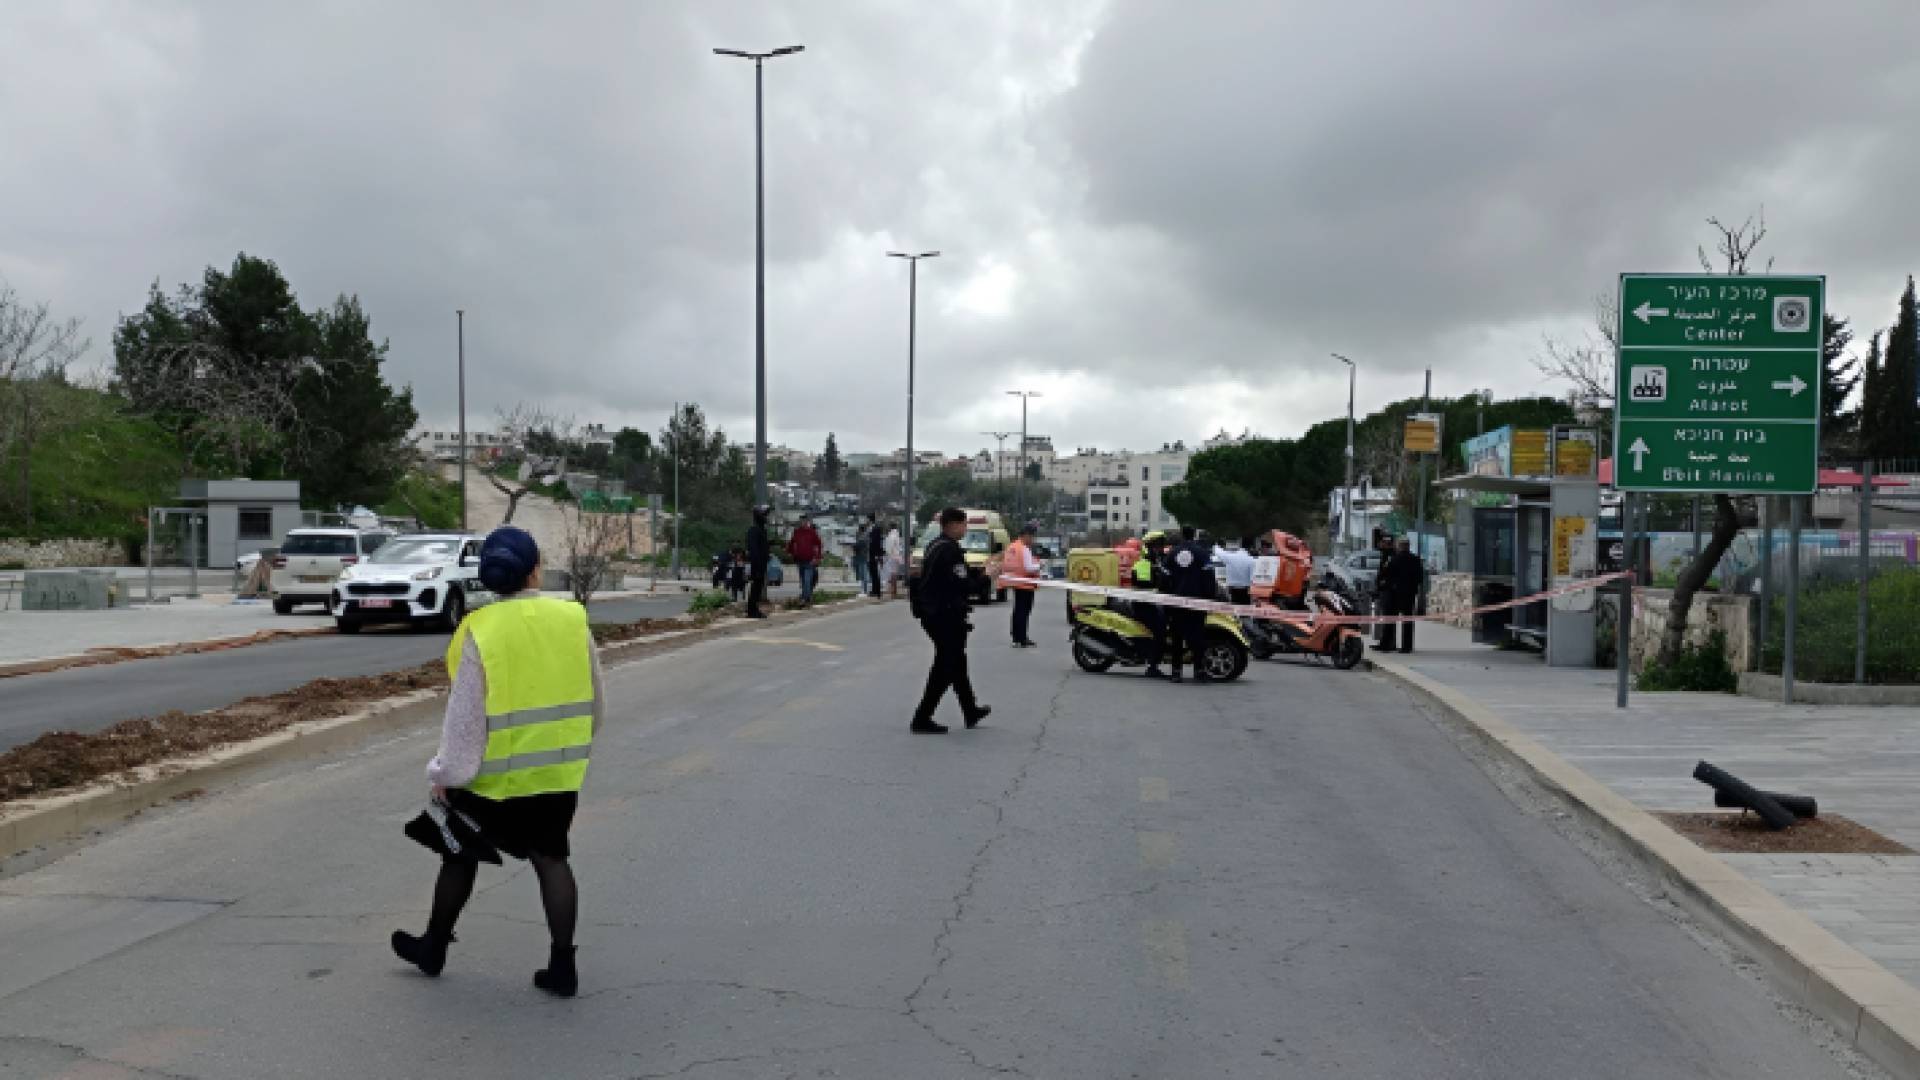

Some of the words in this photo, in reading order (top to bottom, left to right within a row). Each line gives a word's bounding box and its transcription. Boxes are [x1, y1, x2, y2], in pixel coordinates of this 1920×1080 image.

[1666, 286, 1710, 300] העיר
[1719, 286, 1767, 300] מרכז
[1684, 326, 1744, 340] Center
[1690, 358, 1750, 373] עטרות
[1734, 428, 1767, 443] בית
